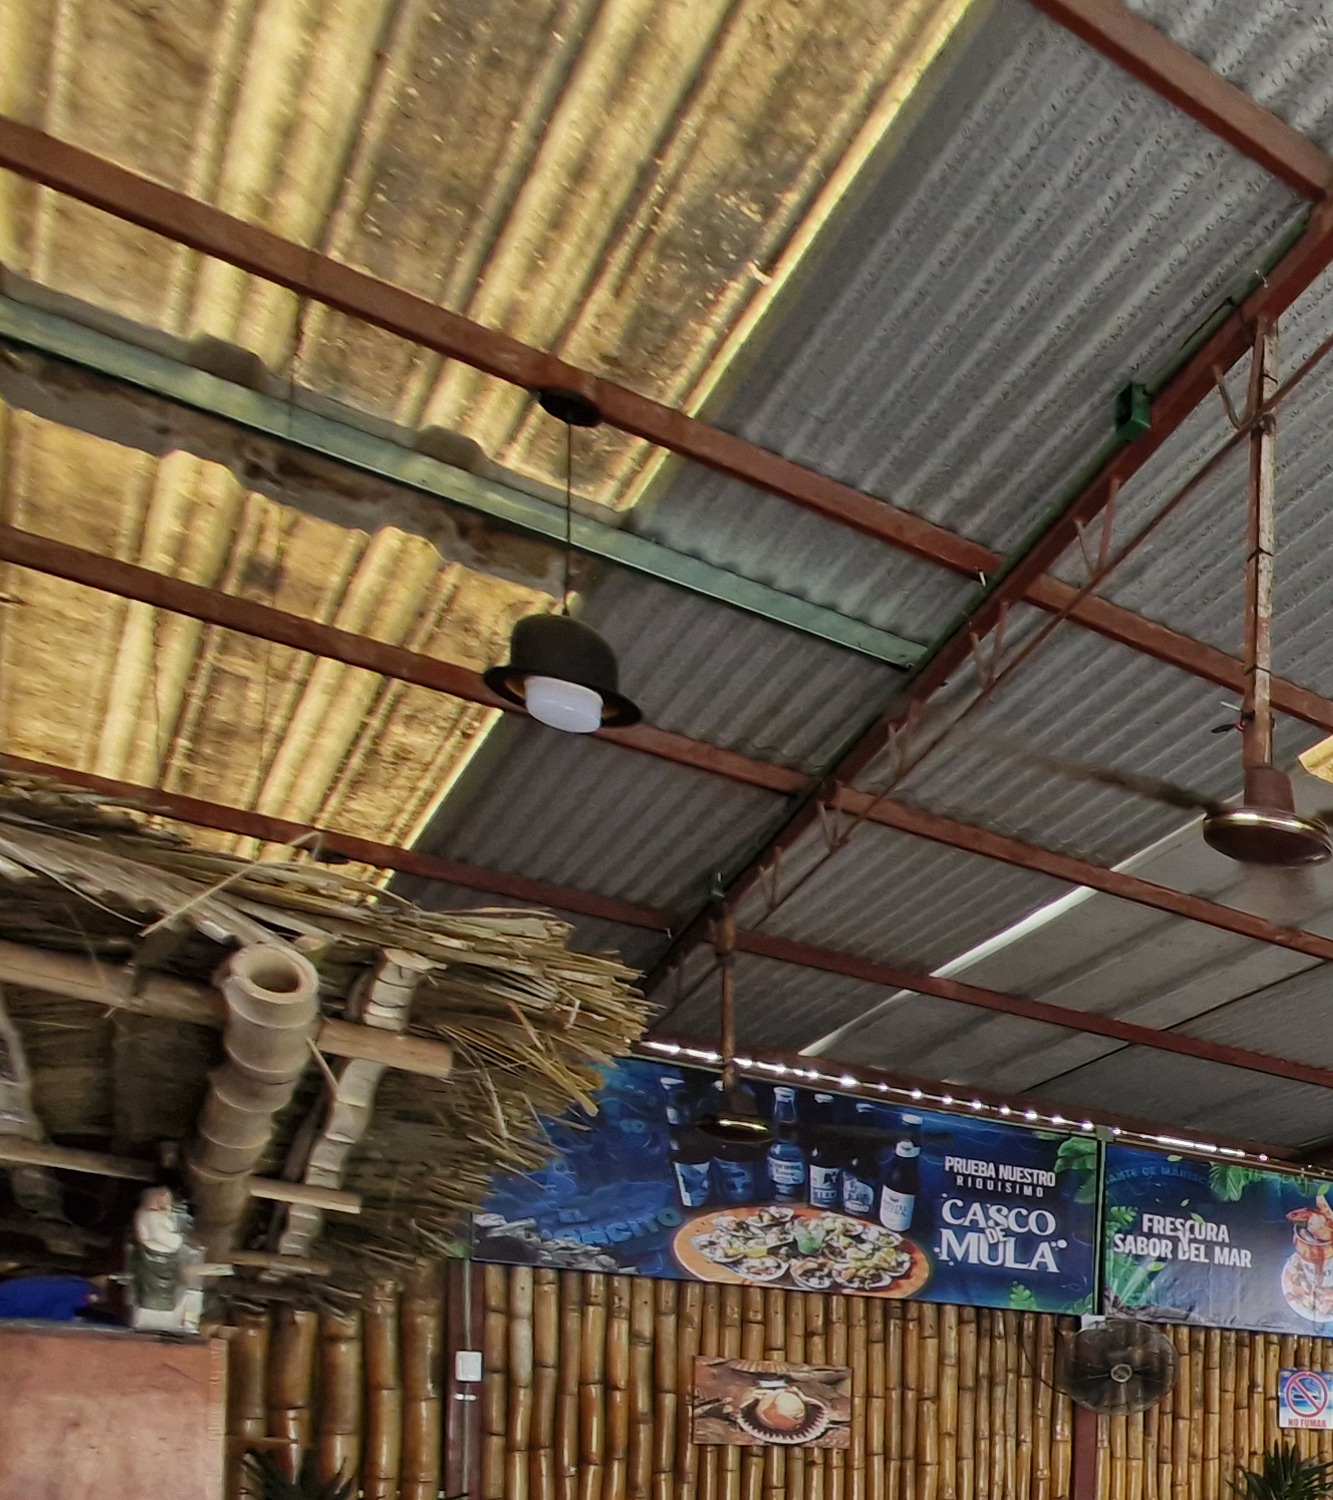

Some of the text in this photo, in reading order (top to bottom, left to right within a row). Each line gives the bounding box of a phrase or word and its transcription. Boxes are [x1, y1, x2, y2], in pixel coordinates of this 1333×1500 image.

[944, 1156, 1056, 1187] PRUEBA NUESTRO
[956, 1175, 1044, 1198] RIQUISIMO
[941, 1199, 1056, 1236] CASCO
[1142, 1213, 1230, 1244] FRESCURA
[939, 1228, 1060, 1273] MULA
[985, 1226, 1008, 1244] DE
[1113, 1233, 1252, 1268] SABOR DEL MAR
[1288, 1418, 1299, 1427] NO
